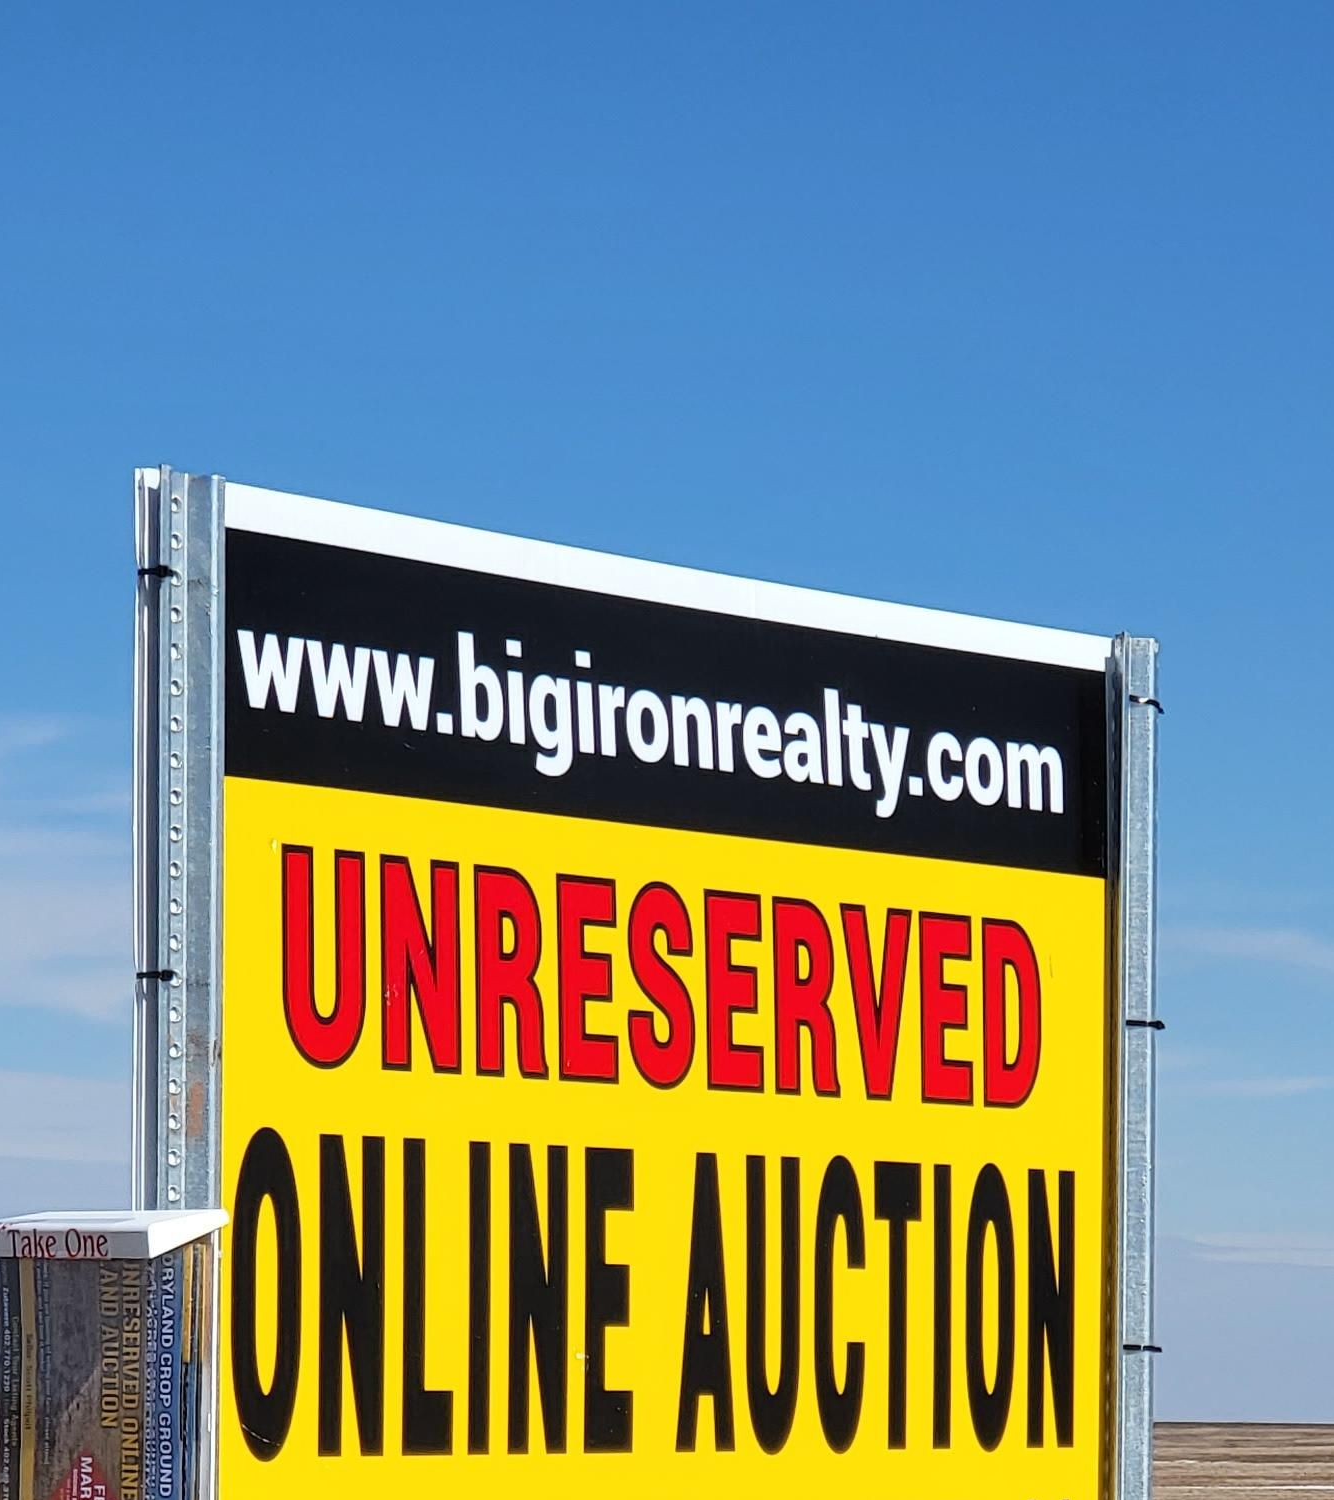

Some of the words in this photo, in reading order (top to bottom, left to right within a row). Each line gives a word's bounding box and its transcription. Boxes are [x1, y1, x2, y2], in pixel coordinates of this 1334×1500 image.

[237, 631, 1064, 818] www.bigironrealty.com
[281, 844, 1041, 1108] UNRESERVED
[8, 1229, 56, 1257] Take
[65, 1228, 108, 1257] One
[99, 1263, 119, 1316] AND
[230, 1126, 633, 1461] ONLINE
[676, 1153, 1075, 1453] AUCTION
[100, 1325, 119, 1428] AUCTION
[158, 1353, 173, 1408] CROP
[158, 1413, 172, 1497] GROUND
